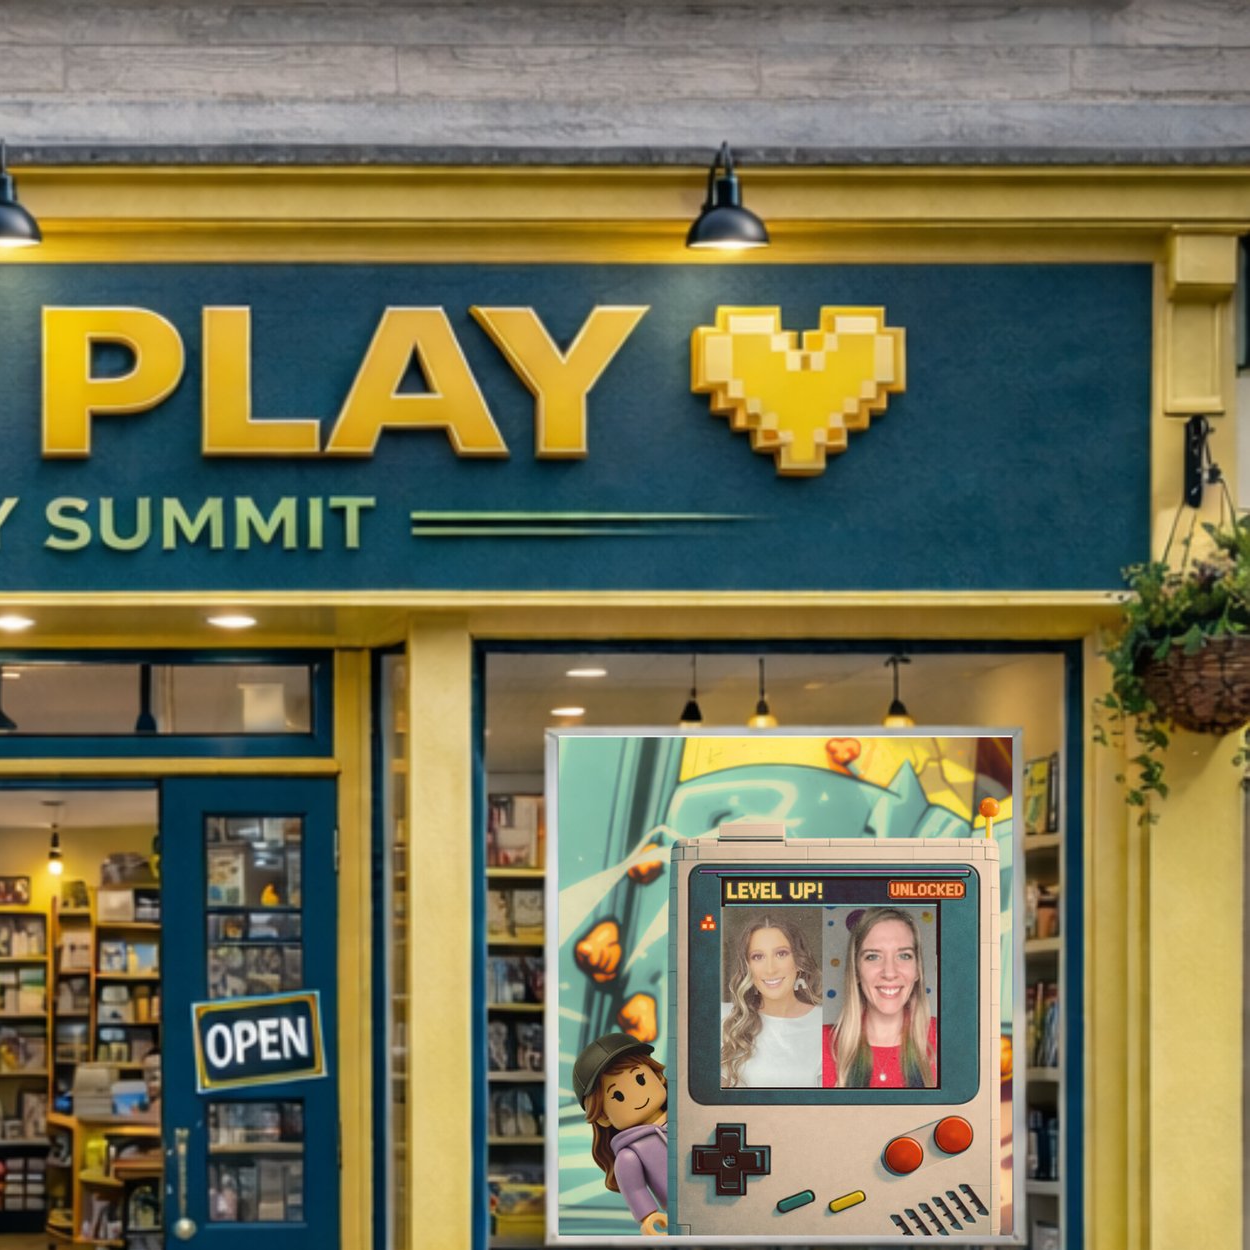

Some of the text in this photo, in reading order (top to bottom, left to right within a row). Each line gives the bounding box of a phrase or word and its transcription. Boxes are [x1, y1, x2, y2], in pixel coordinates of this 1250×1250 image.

[42, 304, 651, 459] PLAY
[43, 496, 376, 552] SUMMIT
[726, 882, 824, 899] LEVEL UP!
[890, 882, 965, 897] UNLOCKED
[206, 1016, 309, 1069] OPEN
